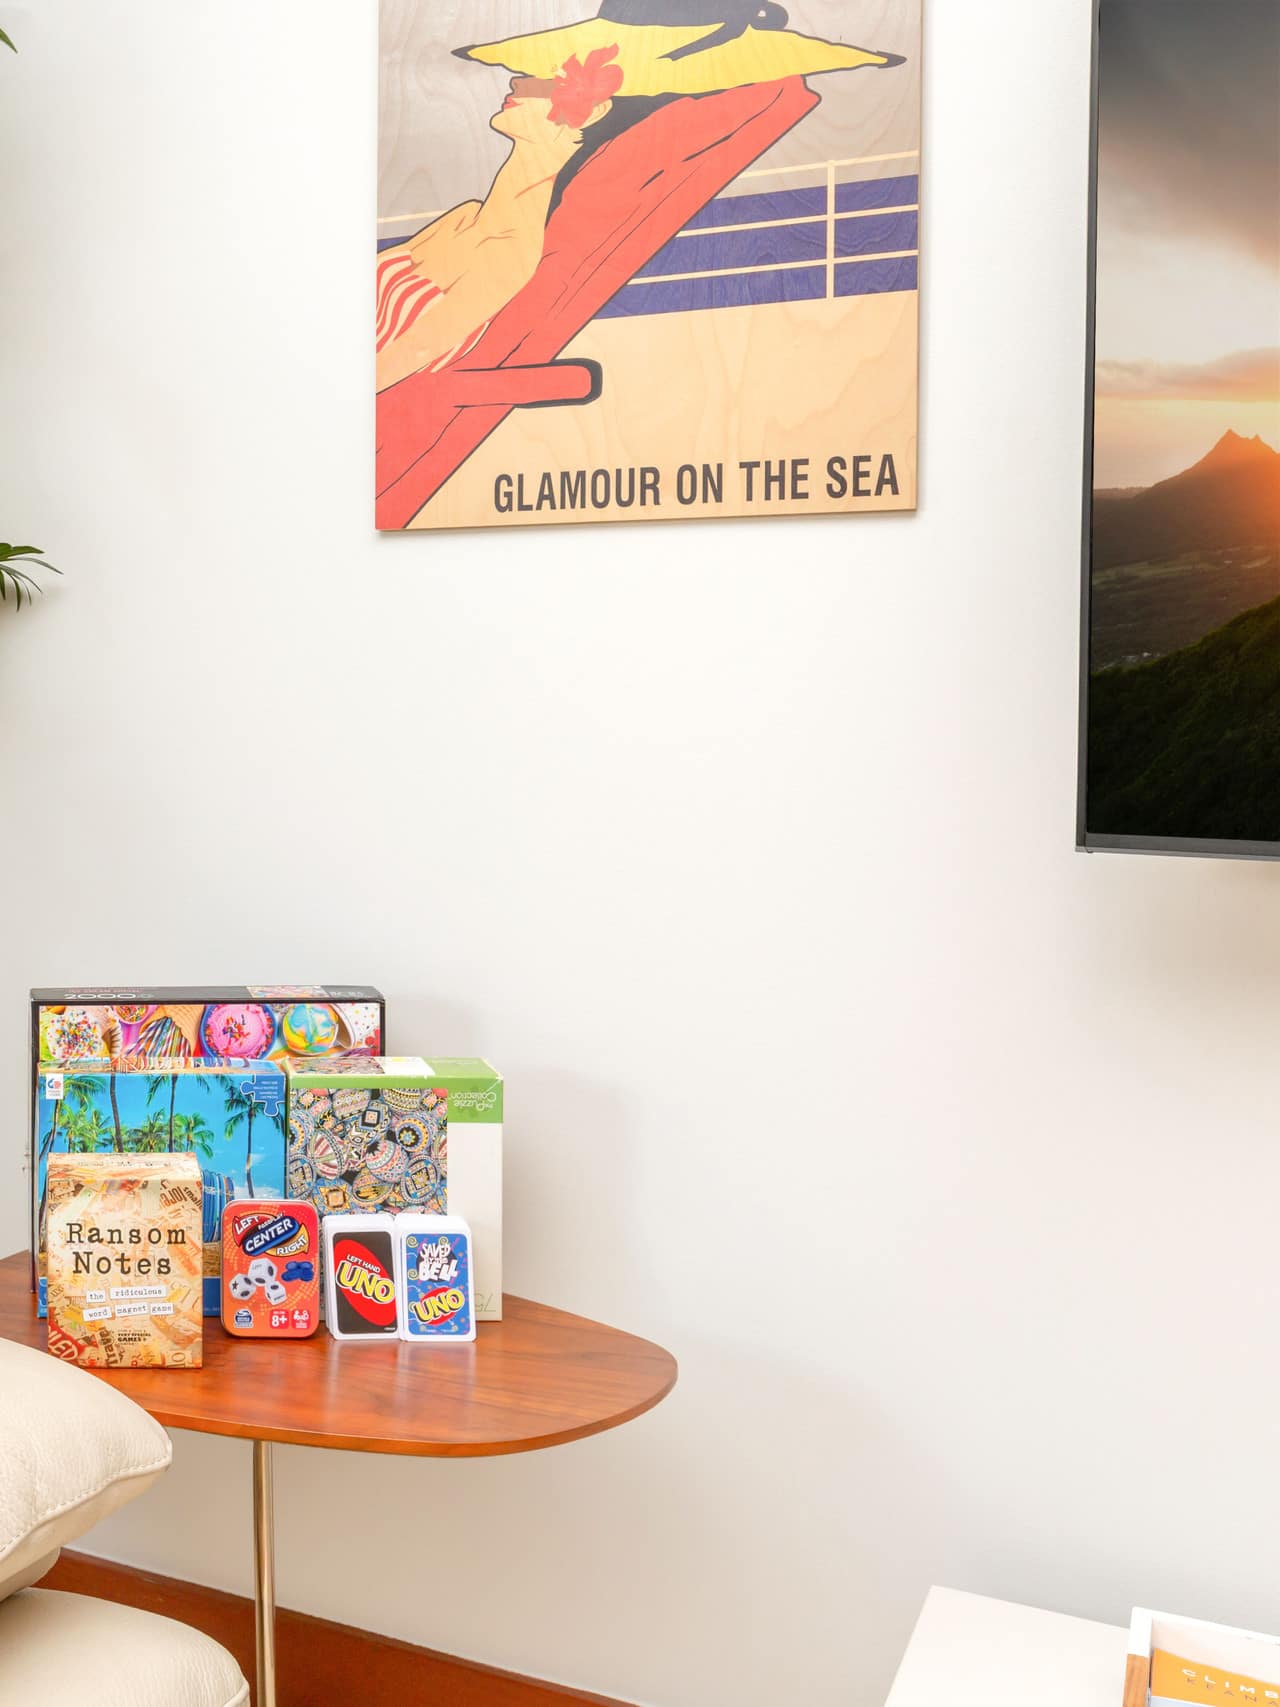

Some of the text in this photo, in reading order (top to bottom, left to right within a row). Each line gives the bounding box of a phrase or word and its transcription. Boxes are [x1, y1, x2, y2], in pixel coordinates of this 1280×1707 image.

[494, 453, 900, 513] GLAMOUR ON THE SEA
[66, 1223, 186, 1245] Ransom
[234, 1215, 259, 1235] LEFT
[245, 1218, 294, 1252] CENTER
[276, 1234, 307, 1255] RIGHT
[419, 1243, 451, 1259] SAVED
[72, 1251, 171, 1275] Notes
[346, 1254, 381, 1273] LEFT HAND
[418, 1259, 459, 1281] BELL
[336, 1260, 395, 1304] UNO
[89, 1287, 162, 1301] the ridiculous
[475, 1292, 497, 1313] 75
[88, 1309, 108, 1319] word
[117, 1305, 147, 1315] magnet
[414, 1289, 465, 1323] UNO
[271, 1314, 288, 1328] 8+
